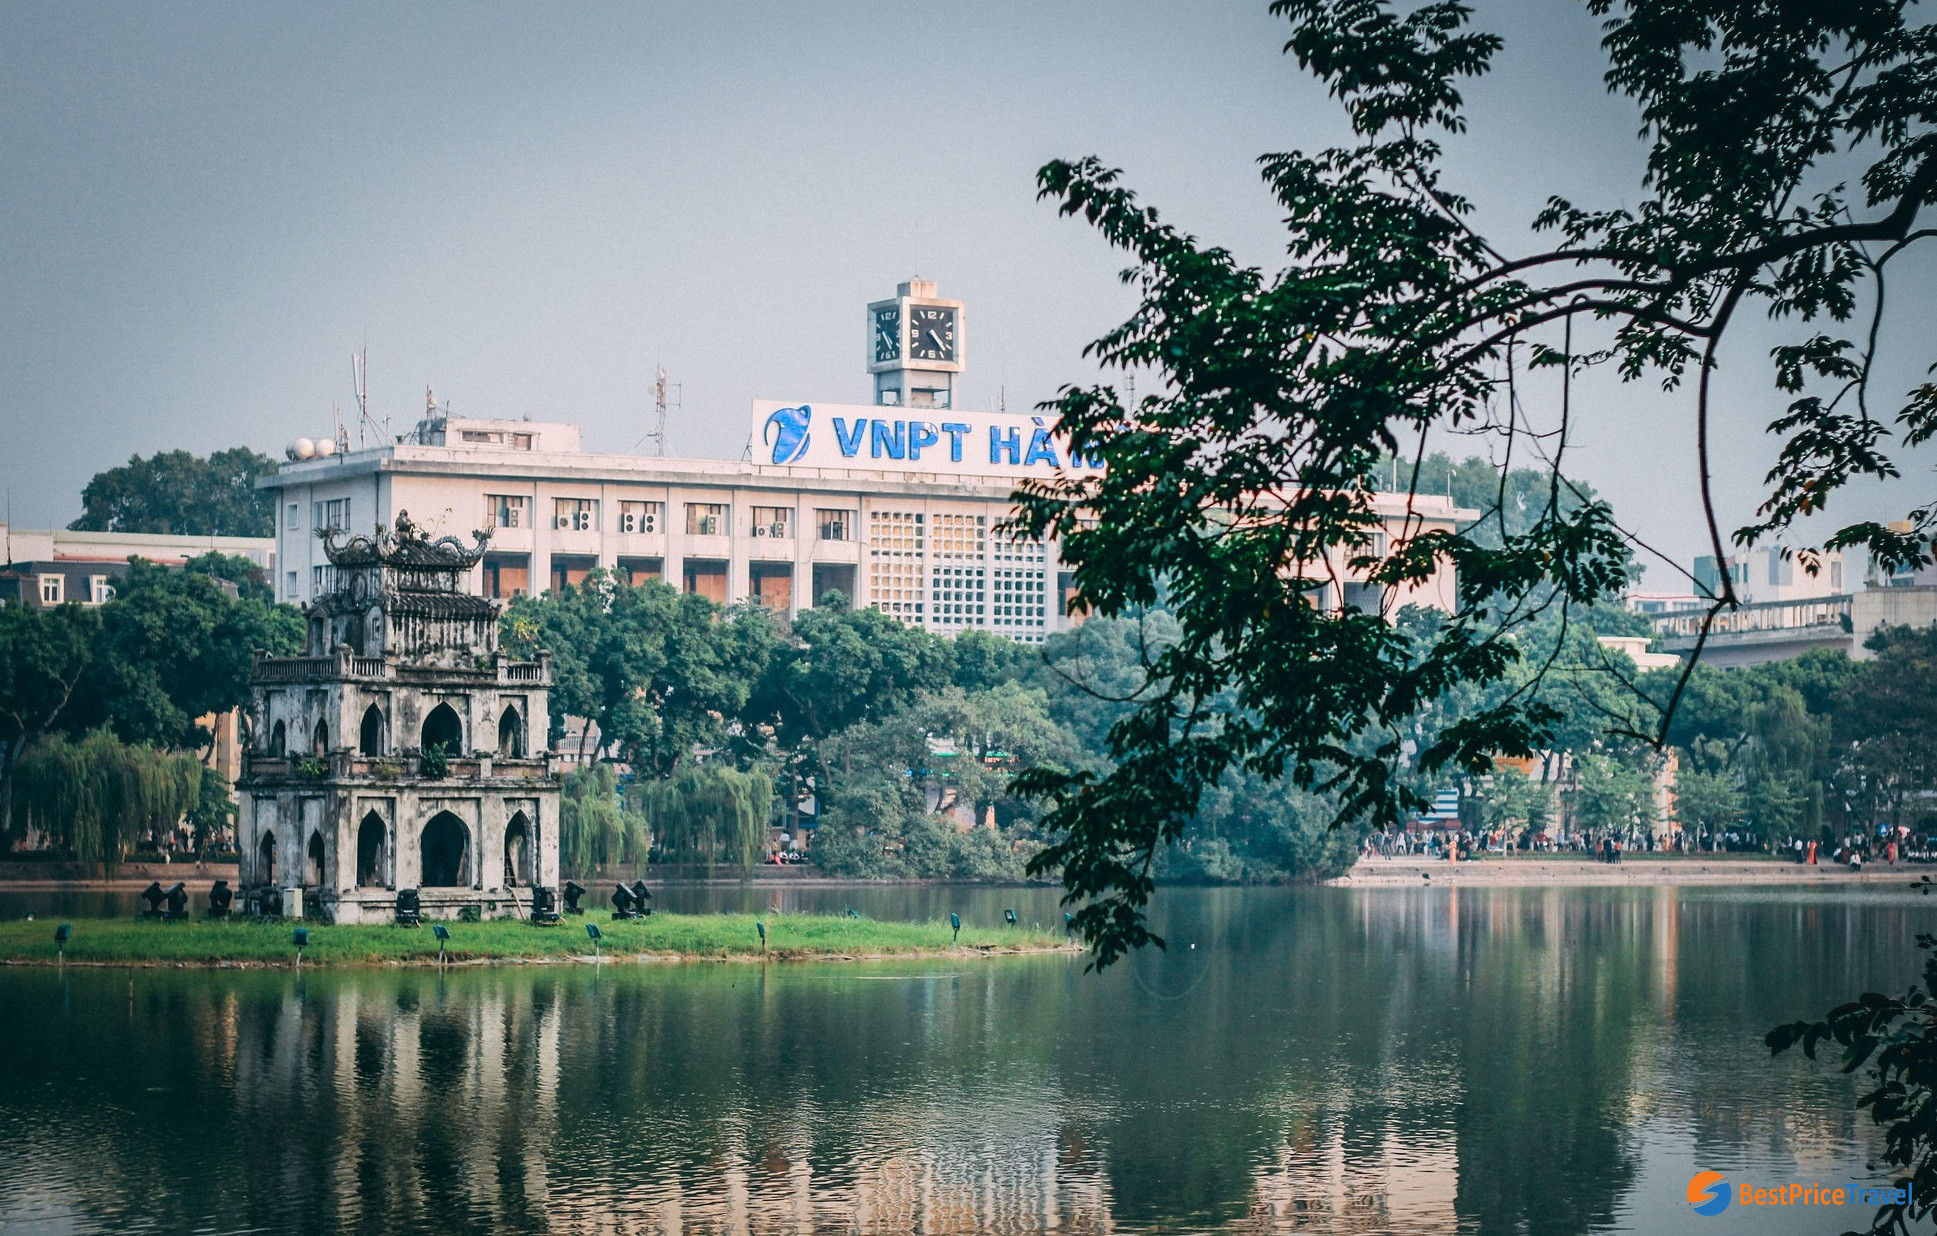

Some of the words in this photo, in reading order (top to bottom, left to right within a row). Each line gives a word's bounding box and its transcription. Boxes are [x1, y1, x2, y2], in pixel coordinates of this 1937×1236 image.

[928, 311, 937, 319] 12
[911, 329, 919, 338] 9
[946, 332, 953, 340] 3
[928, 350, 935, 358] 6
[833, 417, 972, 462] VNPT
[990, 416, 1059, 467] HÀ
